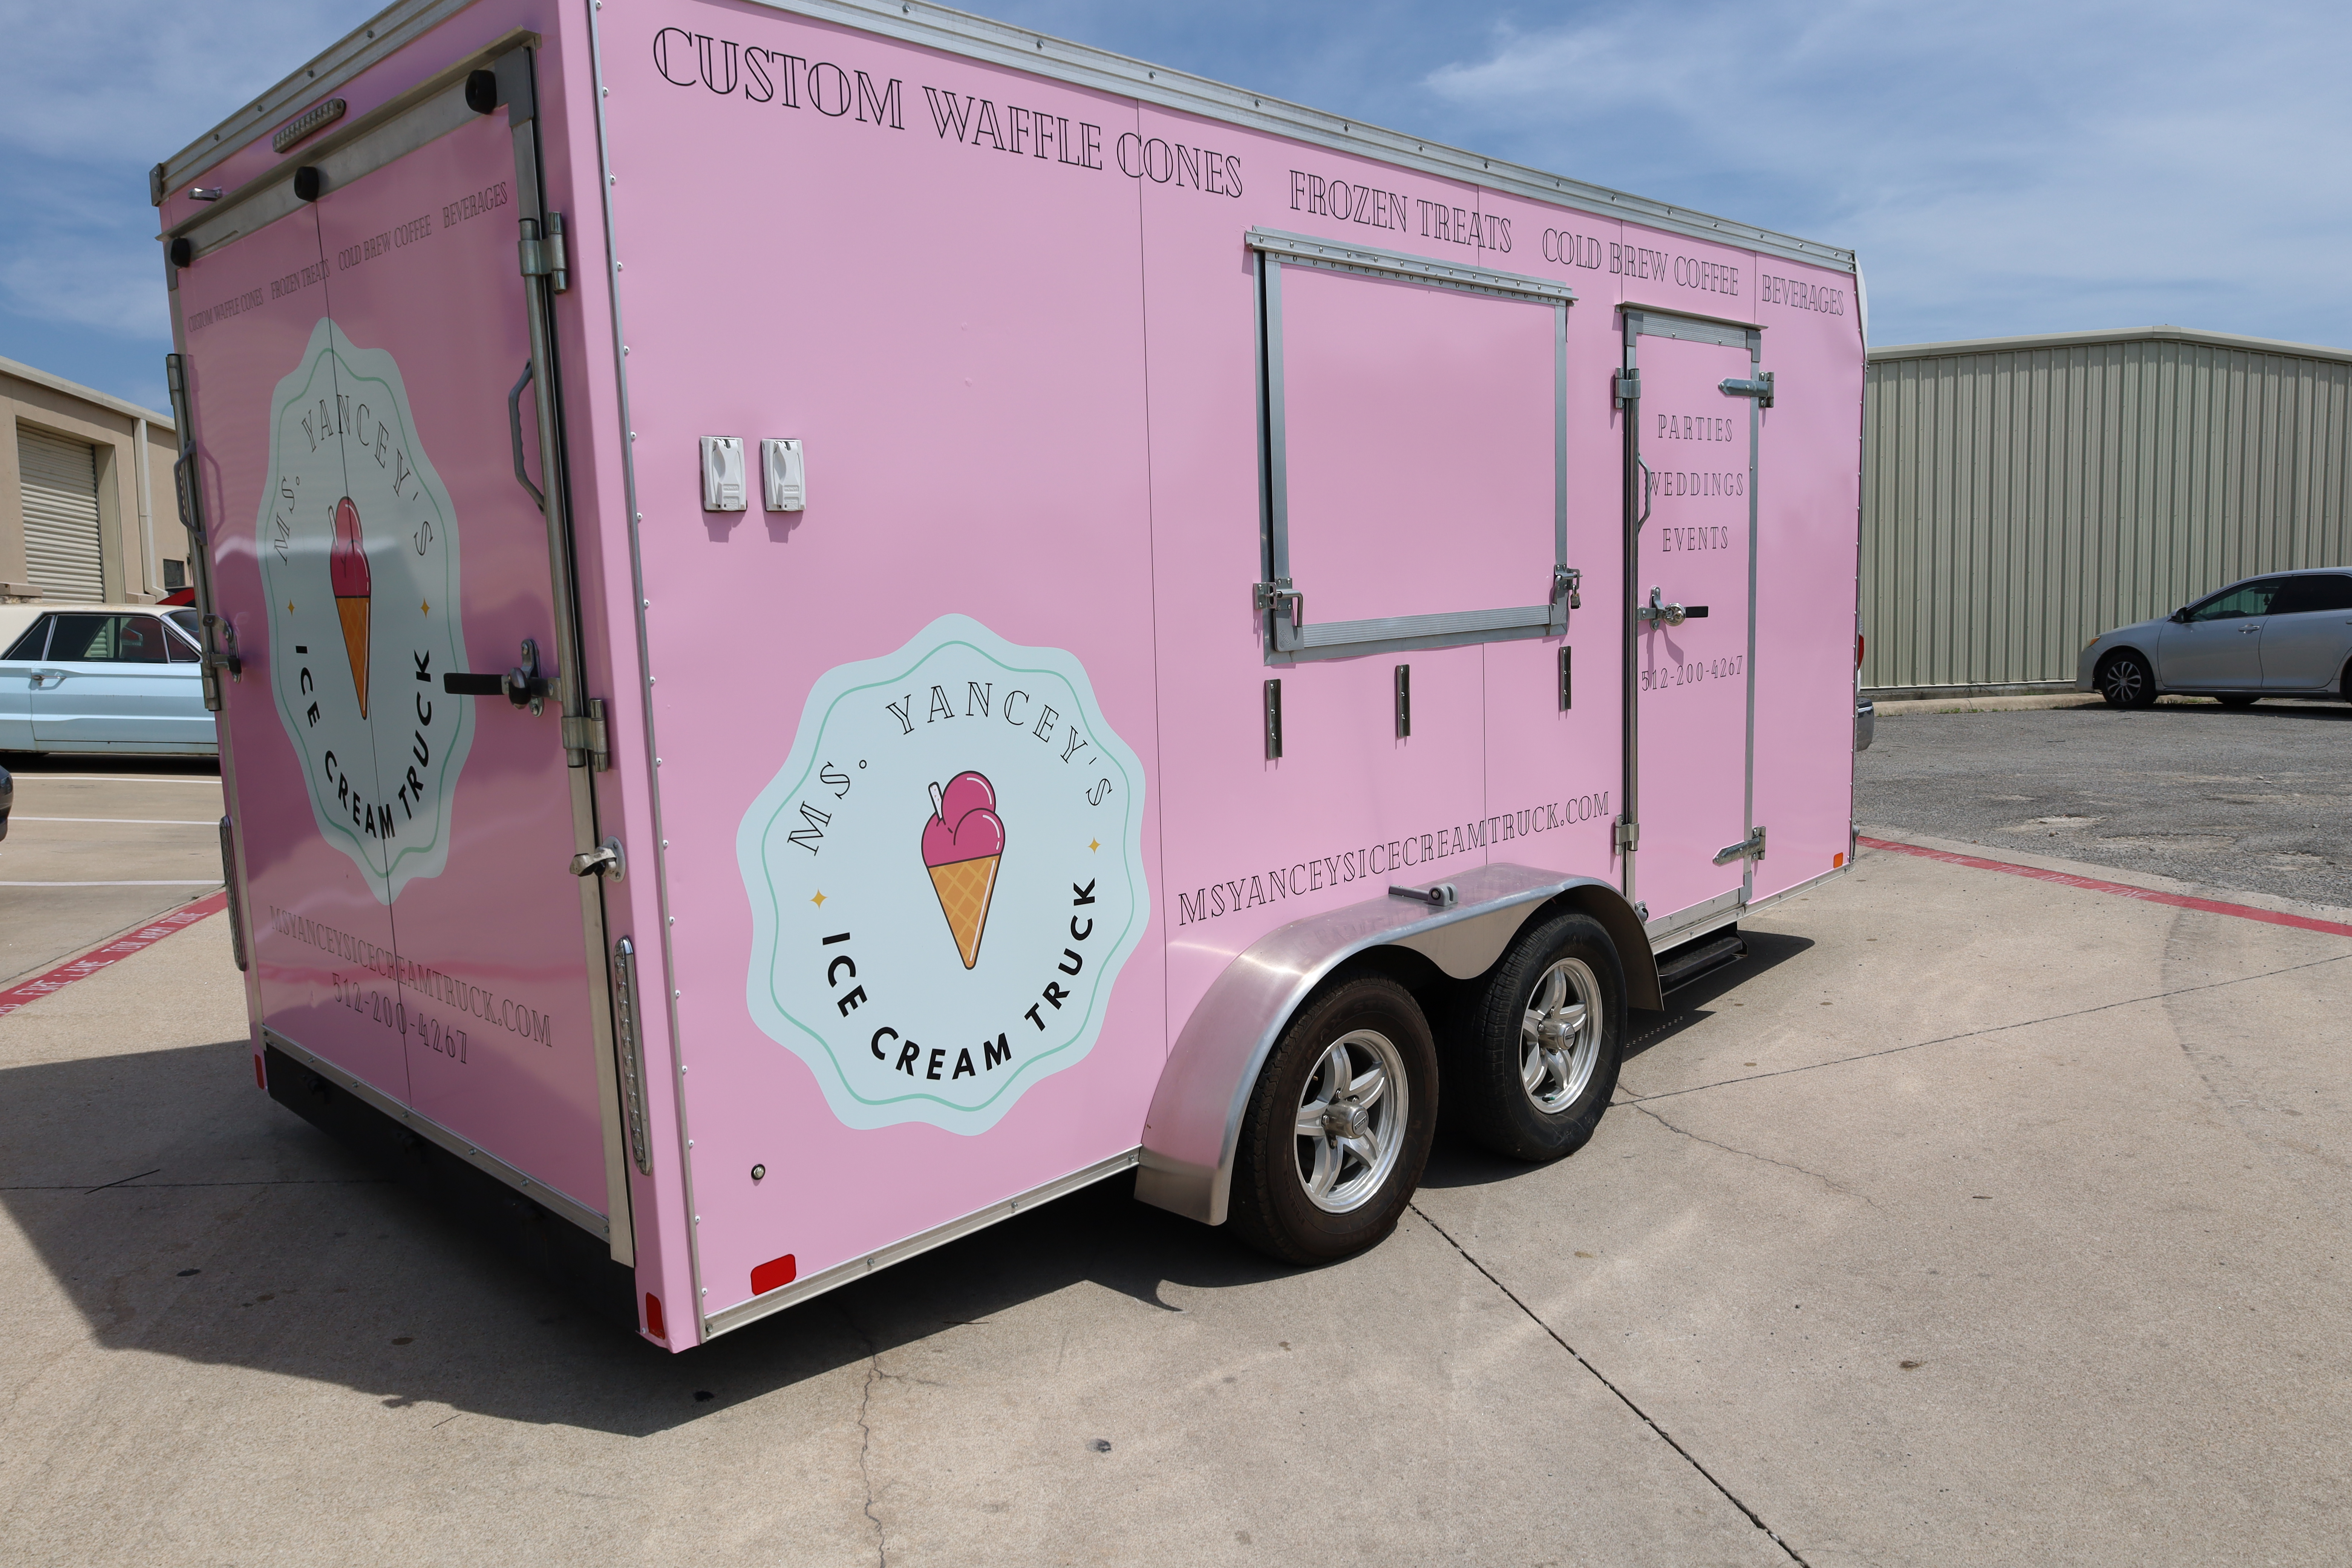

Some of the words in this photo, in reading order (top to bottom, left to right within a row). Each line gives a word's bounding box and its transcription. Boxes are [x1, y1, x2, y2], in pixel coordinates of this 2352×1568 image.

[653, 27, 905, 130] CUSTOM
[922, 86, 1102, 170] WAFFLE
[1117, 132, 1243, 198] CONES
[1289, 169, 1408, 233] FROZEN
[1417, 199, 1512, 253] TREATS
[1543, 228, 1602, 270] COLD
[1609, 243, 1669, 283] BREW
[1674, 256, 1739, 296] COFFEE
[1761, 274, 1844, 316] BEVERAGES
[188, 308, 213, 332] CUSTOM
[214, 298, 240, 321] WAFFLE
[241, 288, 263, 312] CONES
[271, 272, 300, 300] FROZEN
[301, 259, 330, 287] TREATS
[338, 245, 361, 271] COLD
[363, 232, 391, 261] BREW
[394, 215, 431, 248] COFFEE
[443, 182, 507, 228] BEVERAGES
[302, 395, 433, 556] YANCEY'S
[1649, 473, 1744, 496] WEDDINGS
[1658, 415, 1732, 442] PARTIES
[1663, 527, 1728, 551] EVENTS
[1642, 655, 1743, 691] 512-200-4267
[296, 646, 320, 728] ICE
[325, 750, 395, 840] CREAM
[398, 650, 431, 821] TRUCK
[886, 681, 1112, 805] YANCEY'S
[1179, 791, 1609, 926] MSYANCEYSICECREAMTRUCK.COM
[11, 980, 74, 995] FIRE
[54, 960, 115, 976] LANE
[101, 942, 150, 952] TOW
[132, 926, 178, 939] AWAY
[160, 912, 208, 923] ZONE
[270, 906, 552, 1047] MSYANCEYSICECREAMTRUCK.COM
[822, 932, 867, 1017] ICE
[871, 1027, 1012, 1080] CREAM
[1024, 877, 1095, 1031] TRUCK
[333, 973, 467, 1064] 512-200-4267
